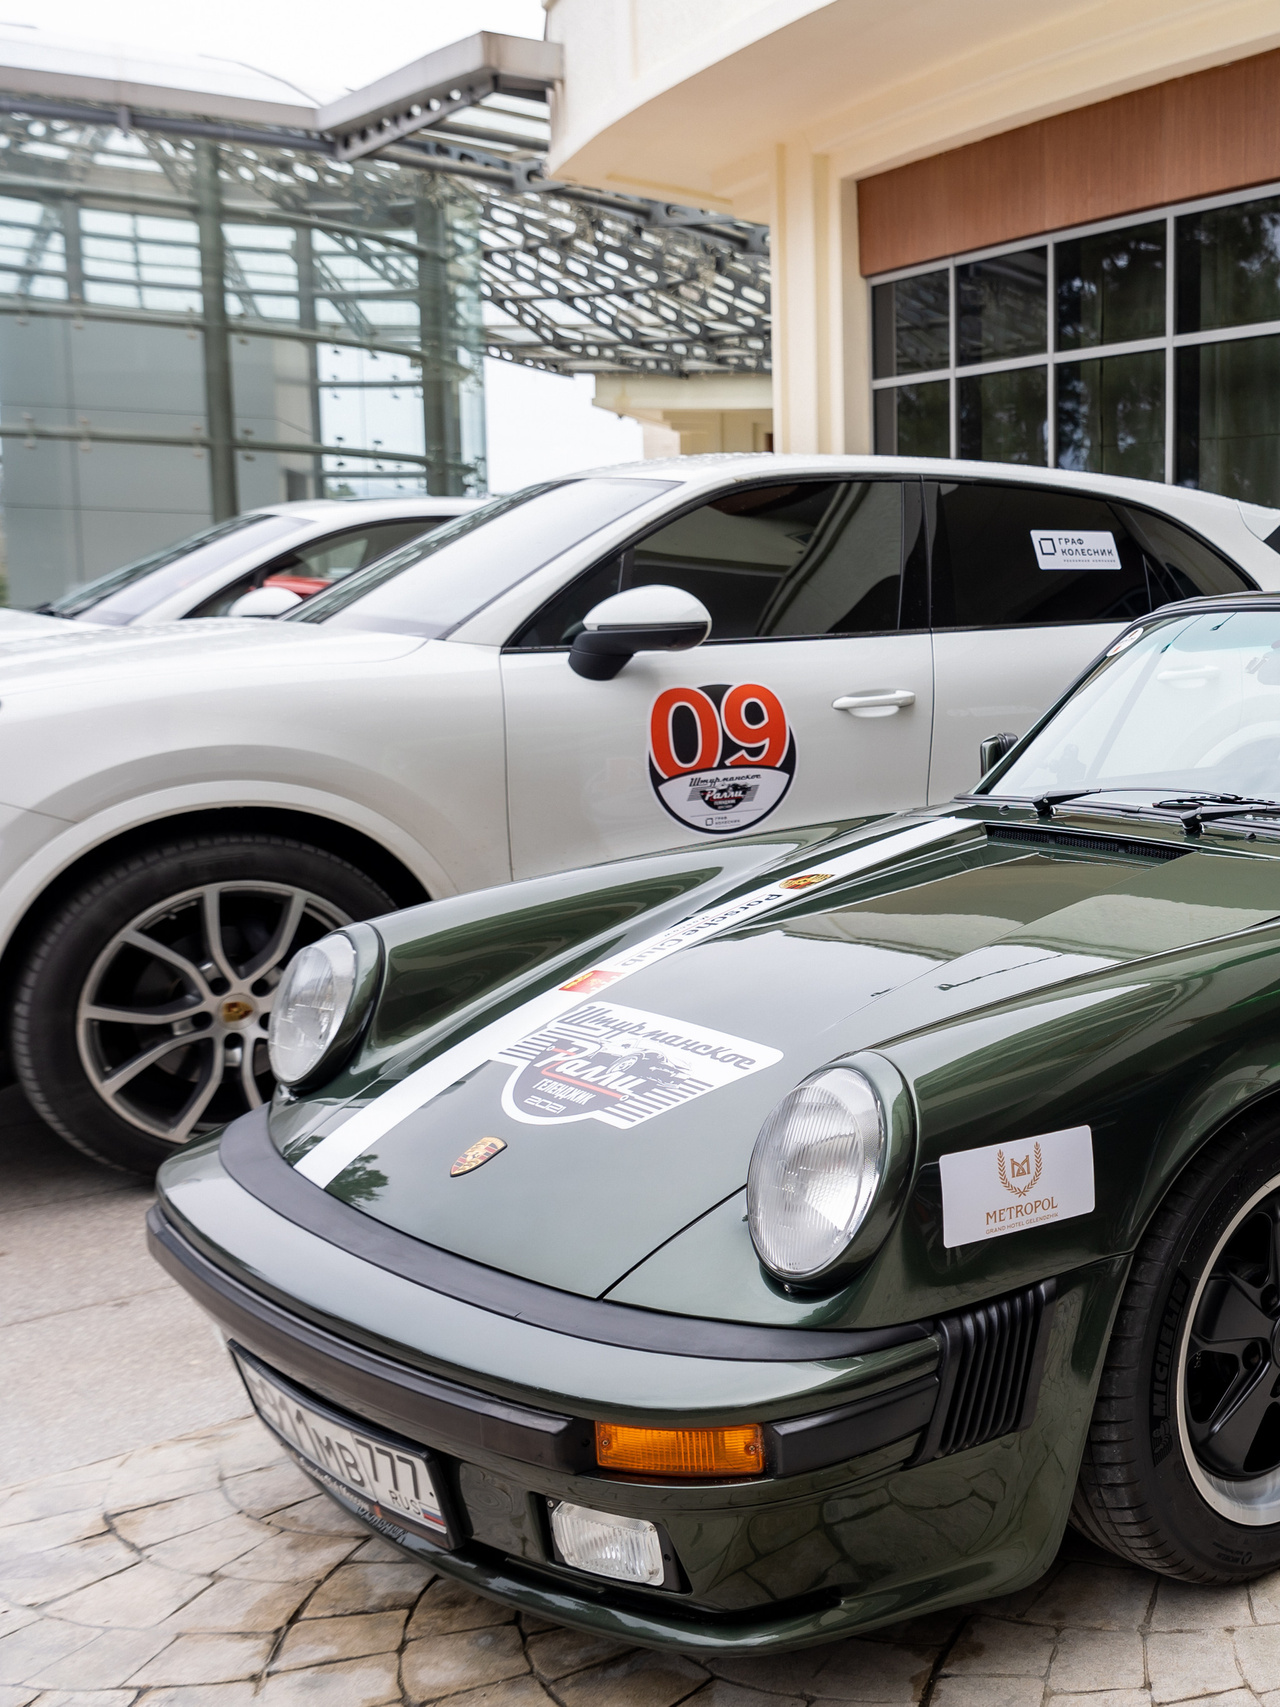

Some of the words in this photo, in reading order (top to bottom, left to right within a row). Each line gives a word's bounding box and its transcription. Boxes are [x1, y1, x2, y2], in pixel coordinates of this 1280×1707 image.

[1061, 549, 1114, 557] КОЛЕСНИК
[650, 683, 789, 779] 09
[704, 788, 743, 801] Ралли
[682, 893, 783, 937] Porsche
[620, 938, 683, 967] Club
[557, 1005, 757, 1070] Штурманское
[534, 1039, 647, 1095] Ралли
[523, 1095, 567, 1115] 2021
[532, 1078, 597, 1106] ГЕЛЕНДЖИК
[986, 1197, 1059, 1226] METROPOL
[986, 1225, 1006, 1235] GRAND
[1007, 1221, 1025, 1230] HOTEL
[1025, 1212, 1059, 1225] GELENDZHIK
[1153, 1275, 1190, 1418] MICHELIN
[388, 1489, 422, 1517] RUS
